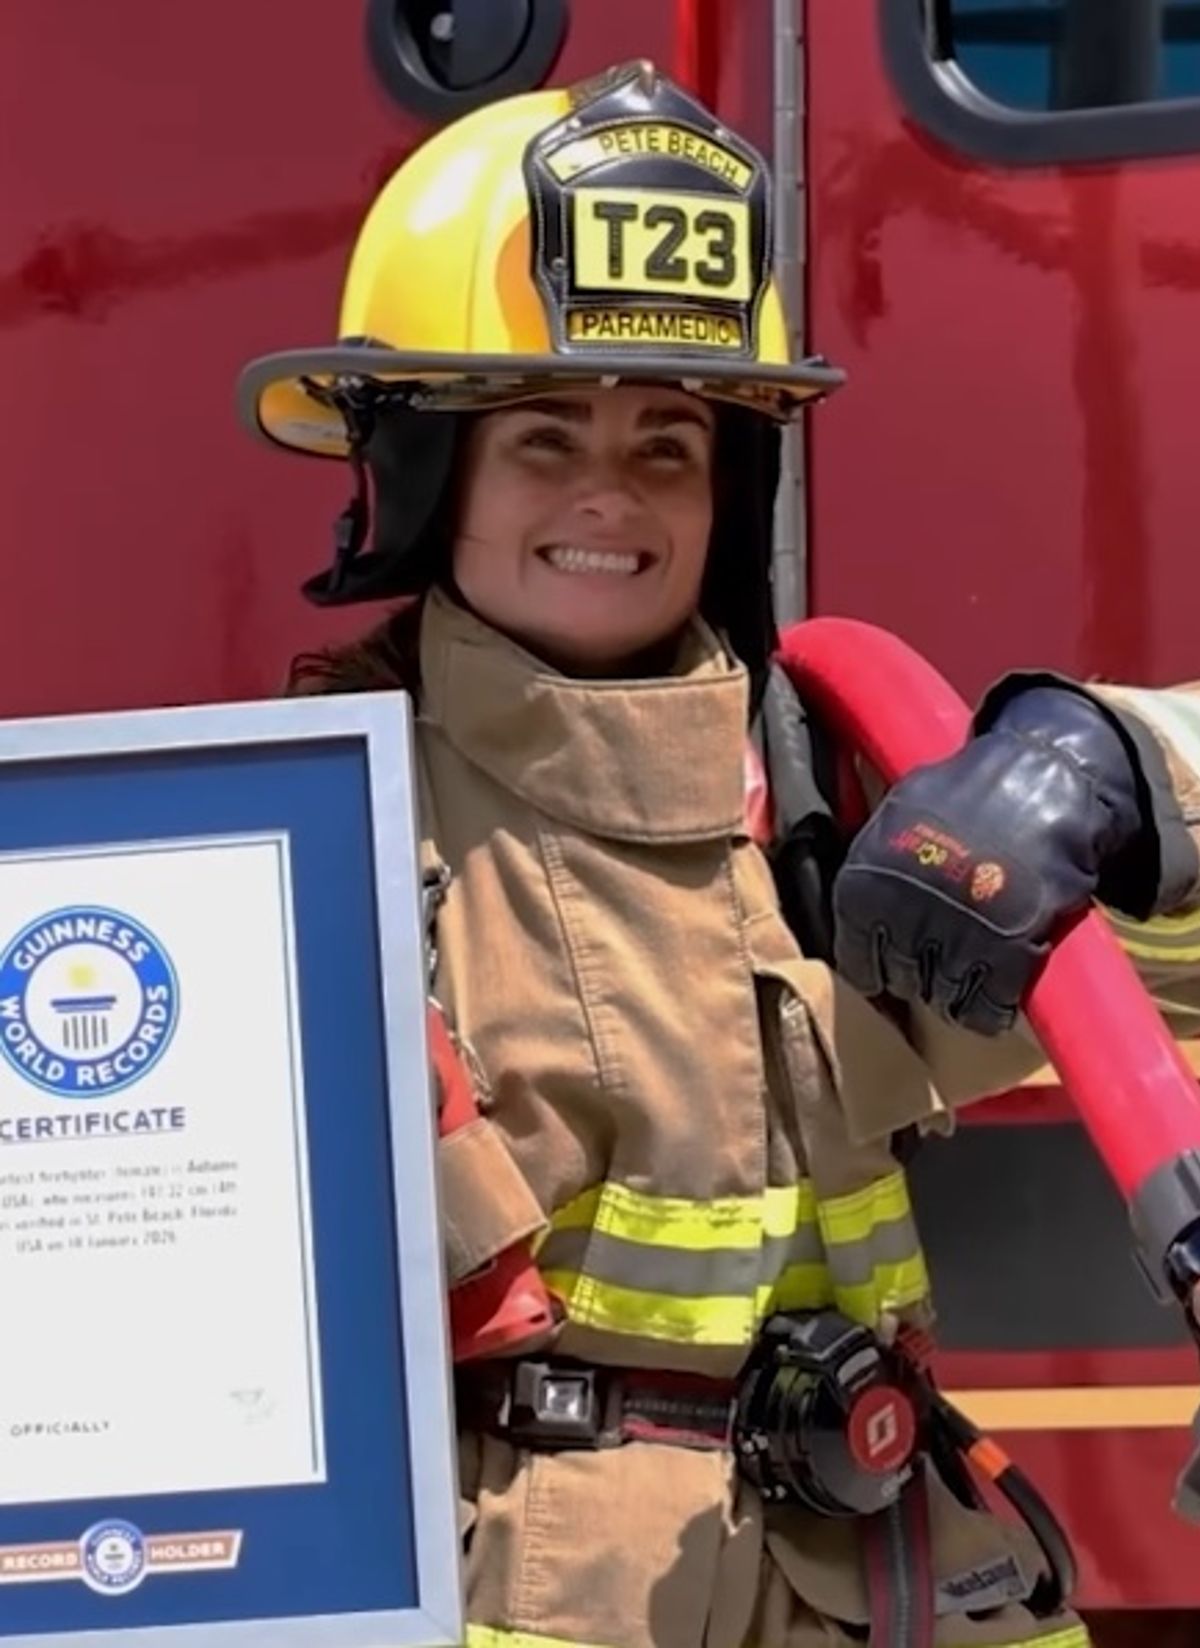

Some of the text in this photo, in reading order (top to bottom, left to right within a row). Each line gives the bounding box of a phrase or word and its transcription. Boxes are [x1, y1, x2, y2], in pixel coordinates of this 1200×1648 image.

[598, 128, 739, 182] PETE BEACH
[592, 200, 737, 288] T23
[581, 311, 733, 343] PARAMEDIC
[12, 917, 151, 972] GUINNESS
[0, 984, 169, 1087] WORLD RECORDS
[0, 1107, 186, 1141] CERTIFICATE
[2, 1540, 226, 1570] RECORD HOLDER
